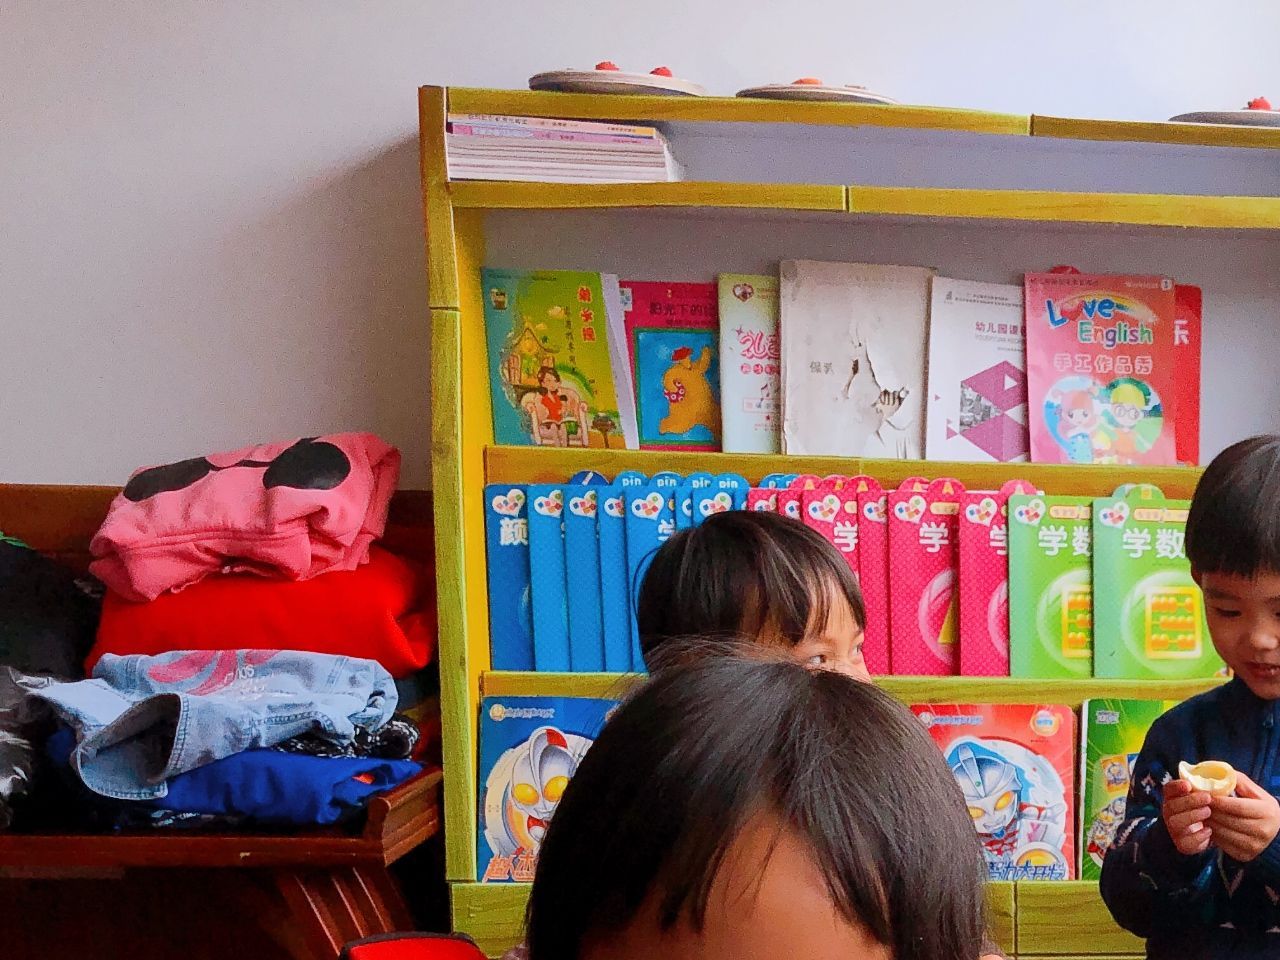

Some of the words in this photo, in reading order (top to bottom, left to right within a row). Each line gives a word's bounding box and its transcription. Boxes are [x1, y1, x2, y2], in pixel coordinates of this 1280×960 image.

[1077, 320, 1153, 349] English
[919, 521, 949, 553] 学
[1122, 528, 1186, 559] 学数
